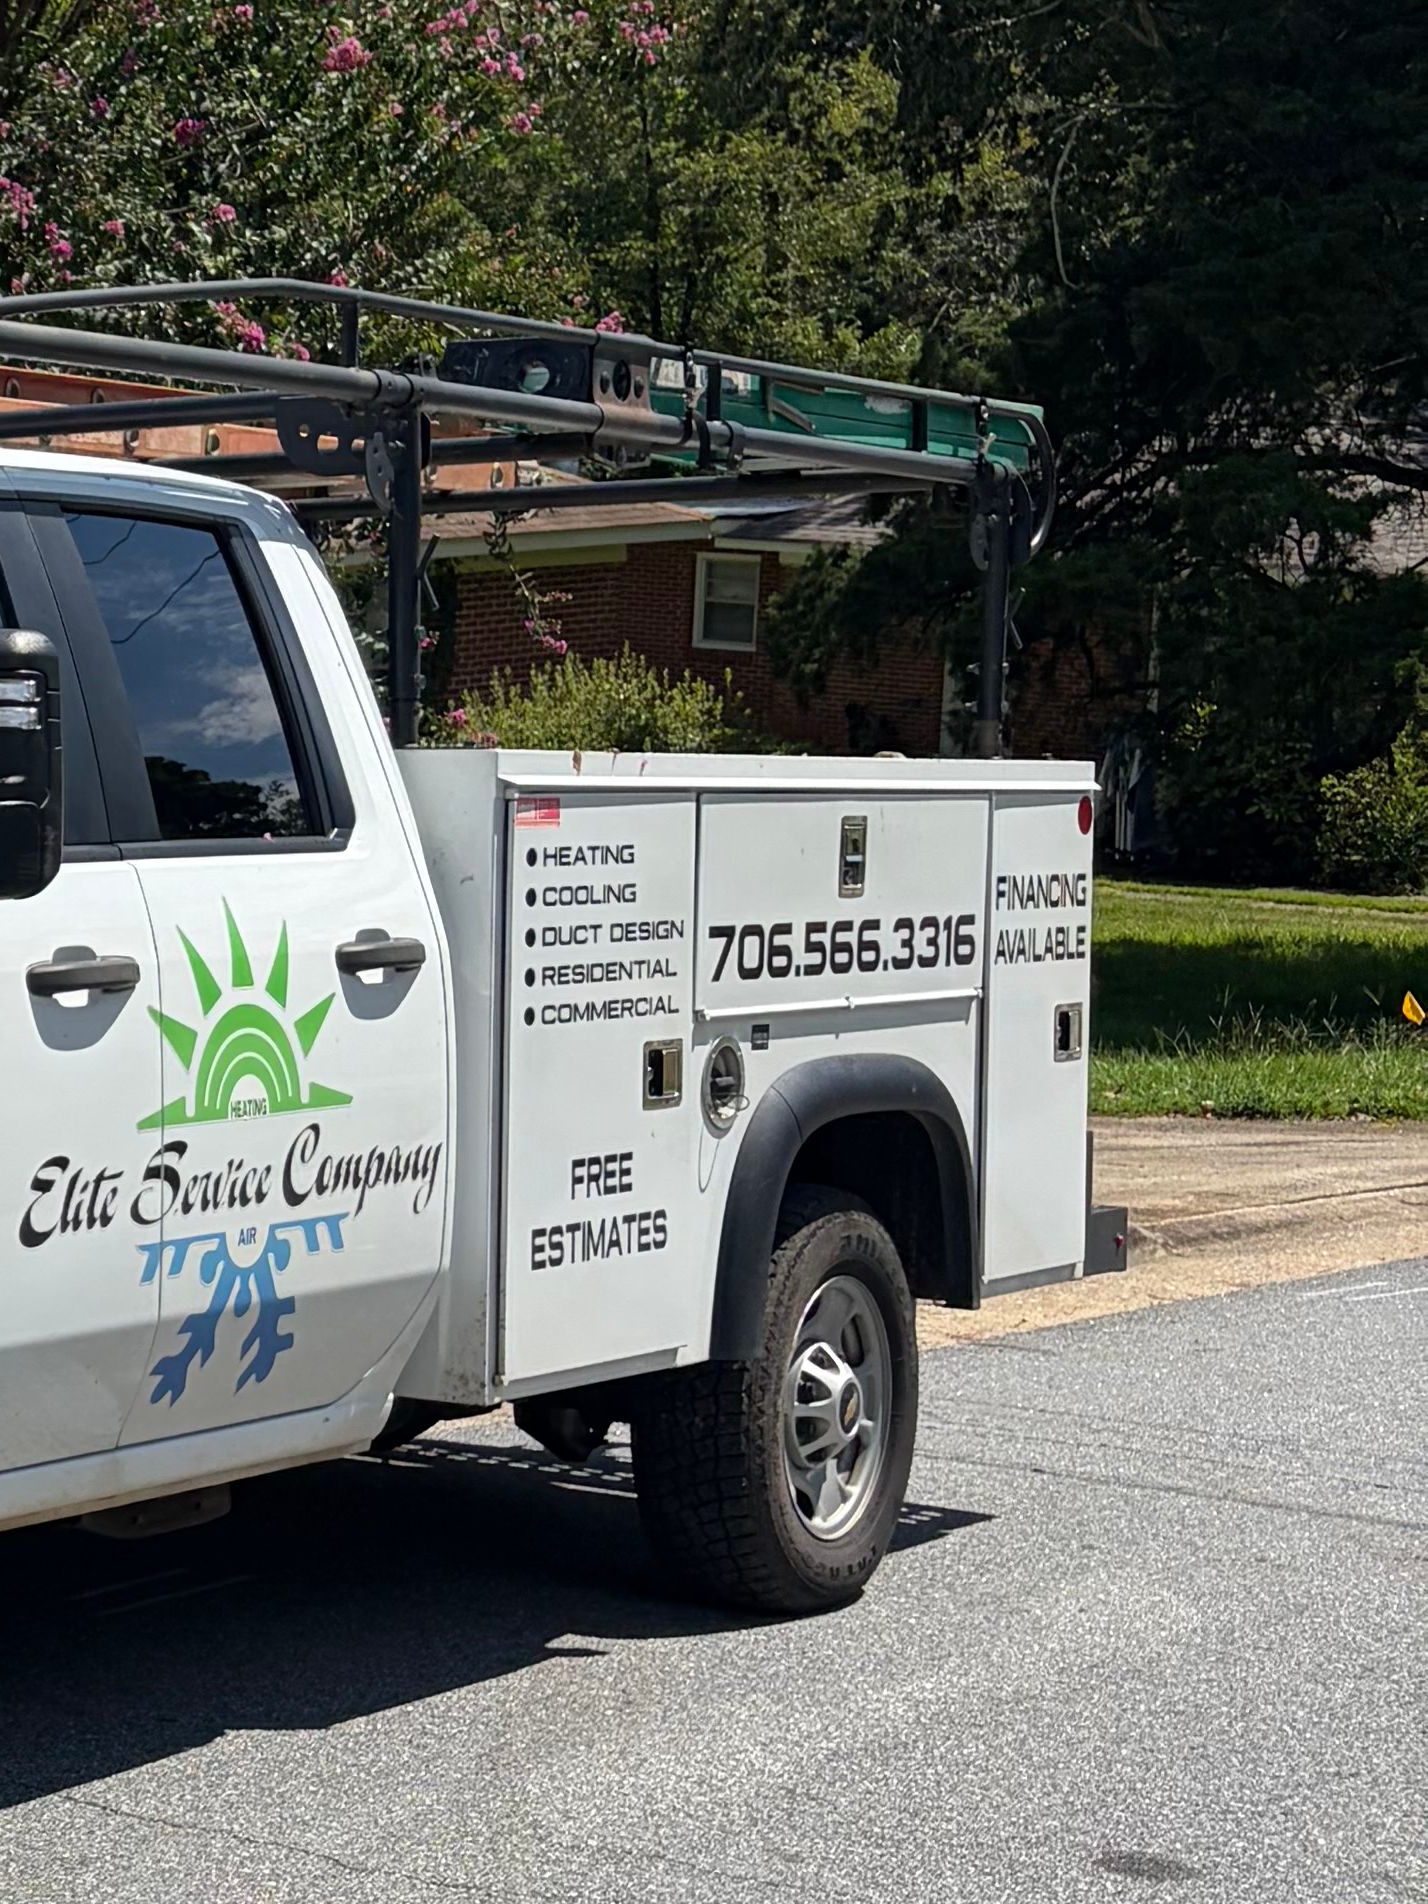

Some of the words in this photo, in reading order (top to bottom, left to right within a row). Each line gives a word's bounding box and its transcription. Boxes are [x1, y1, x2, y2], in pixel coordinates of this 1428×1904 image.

[543, 845, 635, 867] HEATING
[542, 884, 637, 907] COOLING
[996, 873, 1087, 911] FINANCING
[542, 924, 603, 947] DUCT
[610, 920, 684, 943] DESIGN
[708, 914, 976, 983] 706.566.3316
[995, 925, 1087, 965] AVAILABLE
[542, 959, 677, 986] RESIDENTIAL
[541, 995, 679, 1025] COMMERCIAL
[230, 1098, 267, 1118] HEATING
[18, 1156, 124, 1248] Elite
[129, 1141, 272, 1225] Service
[281, 1122, 443, 1217] Company
[571, 1151, 634, 1200] FREE
[237, 1227, 257, 1246] AIR
[531, 1209, 668, 1271] ESTIMATES
